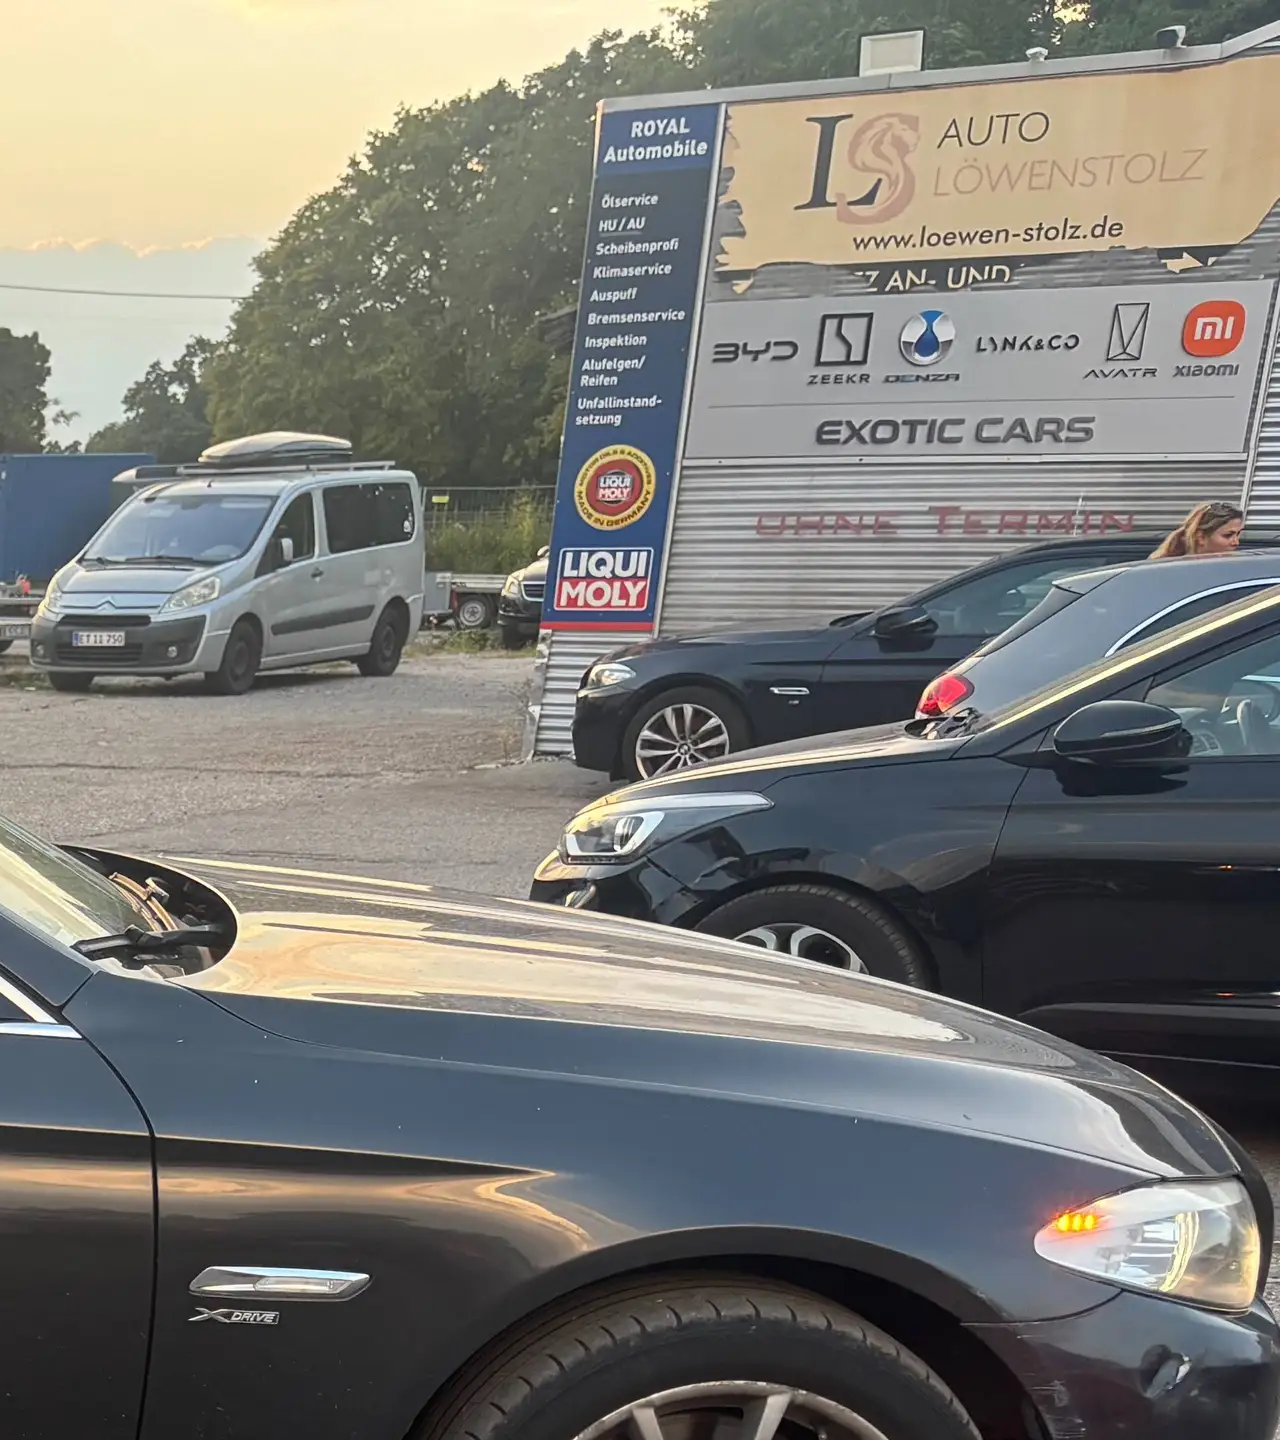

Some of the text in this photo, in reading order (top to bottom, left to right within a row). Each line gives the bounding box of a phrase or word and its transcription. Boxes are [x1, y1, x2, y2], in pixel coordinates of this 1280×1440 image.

[631, 117, 690, 138] ROYAL
[937, 111, 1050, 149] AUTO
[603, 139, 709, 163] Automobile
[933, 148, 1209, 198] LÖWENSTOLZ
[601, 193, 659, 208] Ölservice
[598, 219, 618, 232] HU
[627, 217, 646, 229] AU
[853, 214, 1125, 251] www.loewen-stolz.de
[595, 238, 680, 256] Scheibenprofi
[593, 263, 672, 279] Klimaservice
[590, 287, 638, 303] Auspuff
[587, 308, 686, 325] Bremsenservice
[584, 334, 647, 350] Inspektion
[712, 340, 799, 363] BYD
[581, 356, 646, 372] Alufelgen/
[580, 374, 618, 387] Reifen
[806, 373, 870, 386] ZEEKR
[882, 372, 960, 383] DENZA
[1083, 367, 1158, 379] AVATR
[577, 395, 662, 410] Unfallinstand-
[575, 413, 622, 427] setzung
[815, 416, 1096, 445] EXOTIC CARS
[600, 475, 632, 488] LIQUI
[598, 487, 631, 500] MOLY
[576, 490, 595, 521] MADE
[606, 490, 652, 527] GERMANY
[563, 551, 648, 579] LIQUI
[560, 580, 647, 607] MOLY
